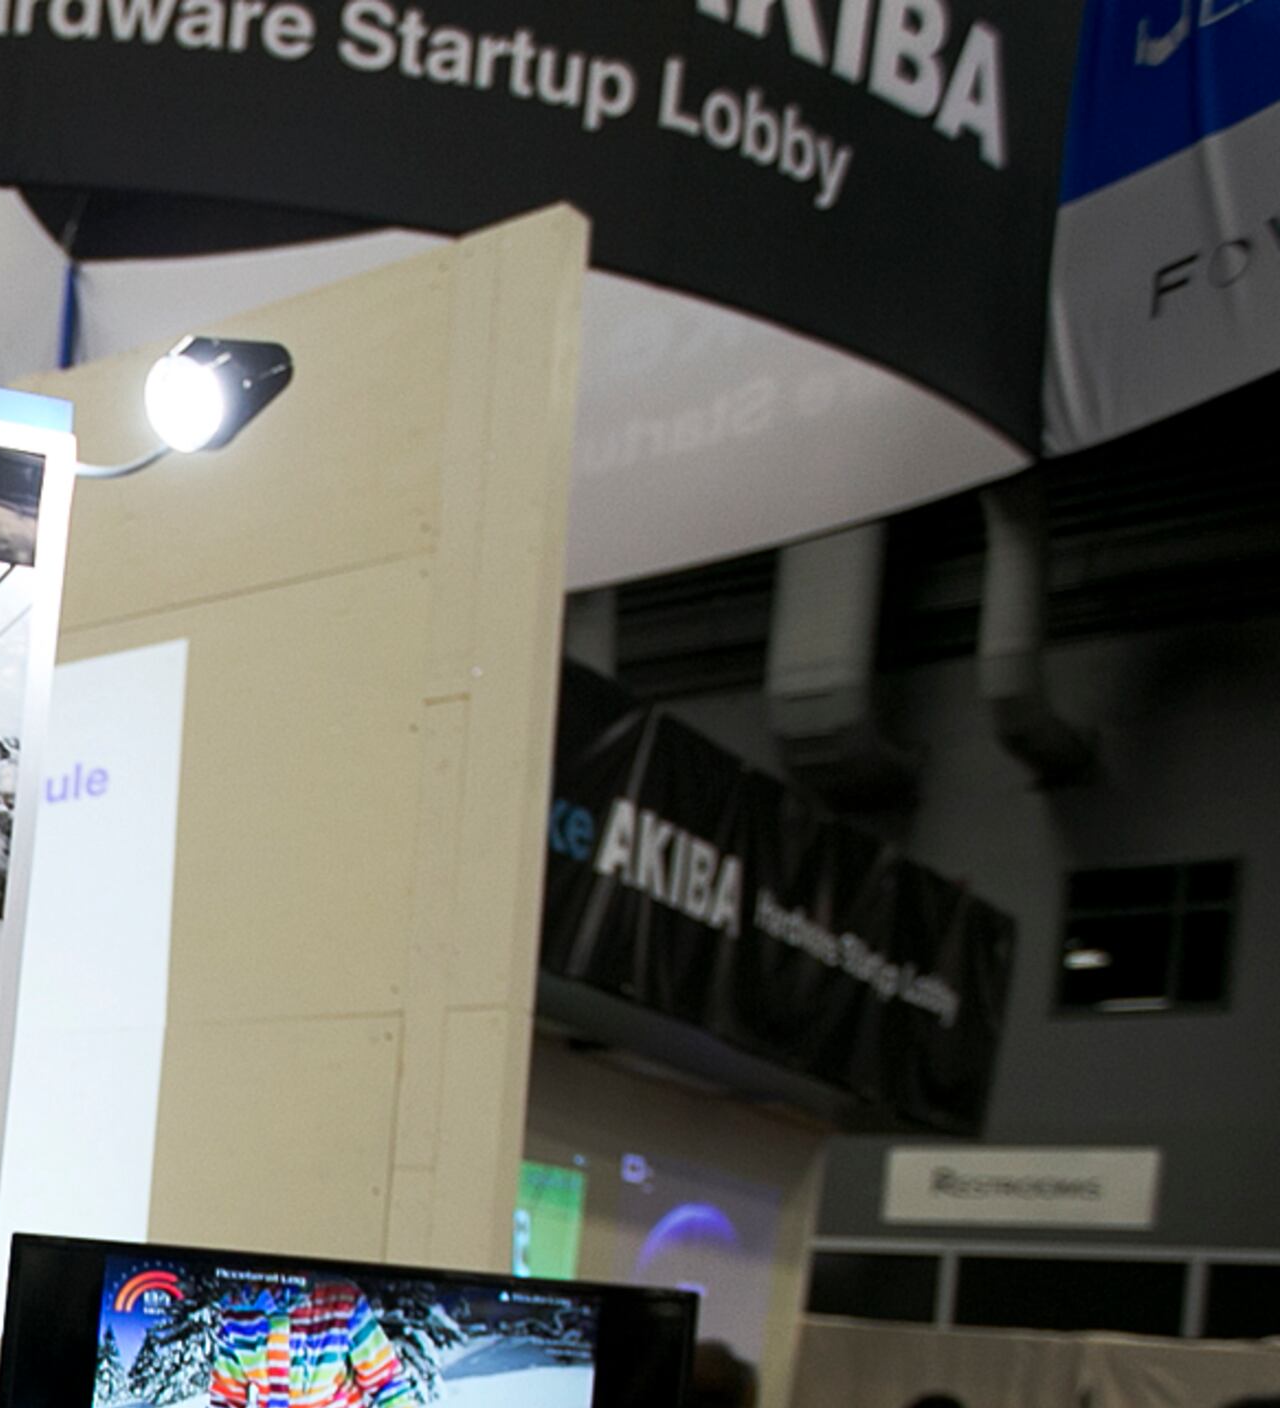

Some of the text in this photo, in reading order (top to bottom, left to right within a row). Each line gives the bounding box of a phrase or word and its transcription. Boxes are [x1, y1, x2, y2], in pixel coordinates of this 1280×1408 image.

[337, 0, 637, 132] Startup
[657, 57, 853, 210] Lobby
[45, 763, 110, 804] ule
[594, 798, 743, 939] AKIBA
